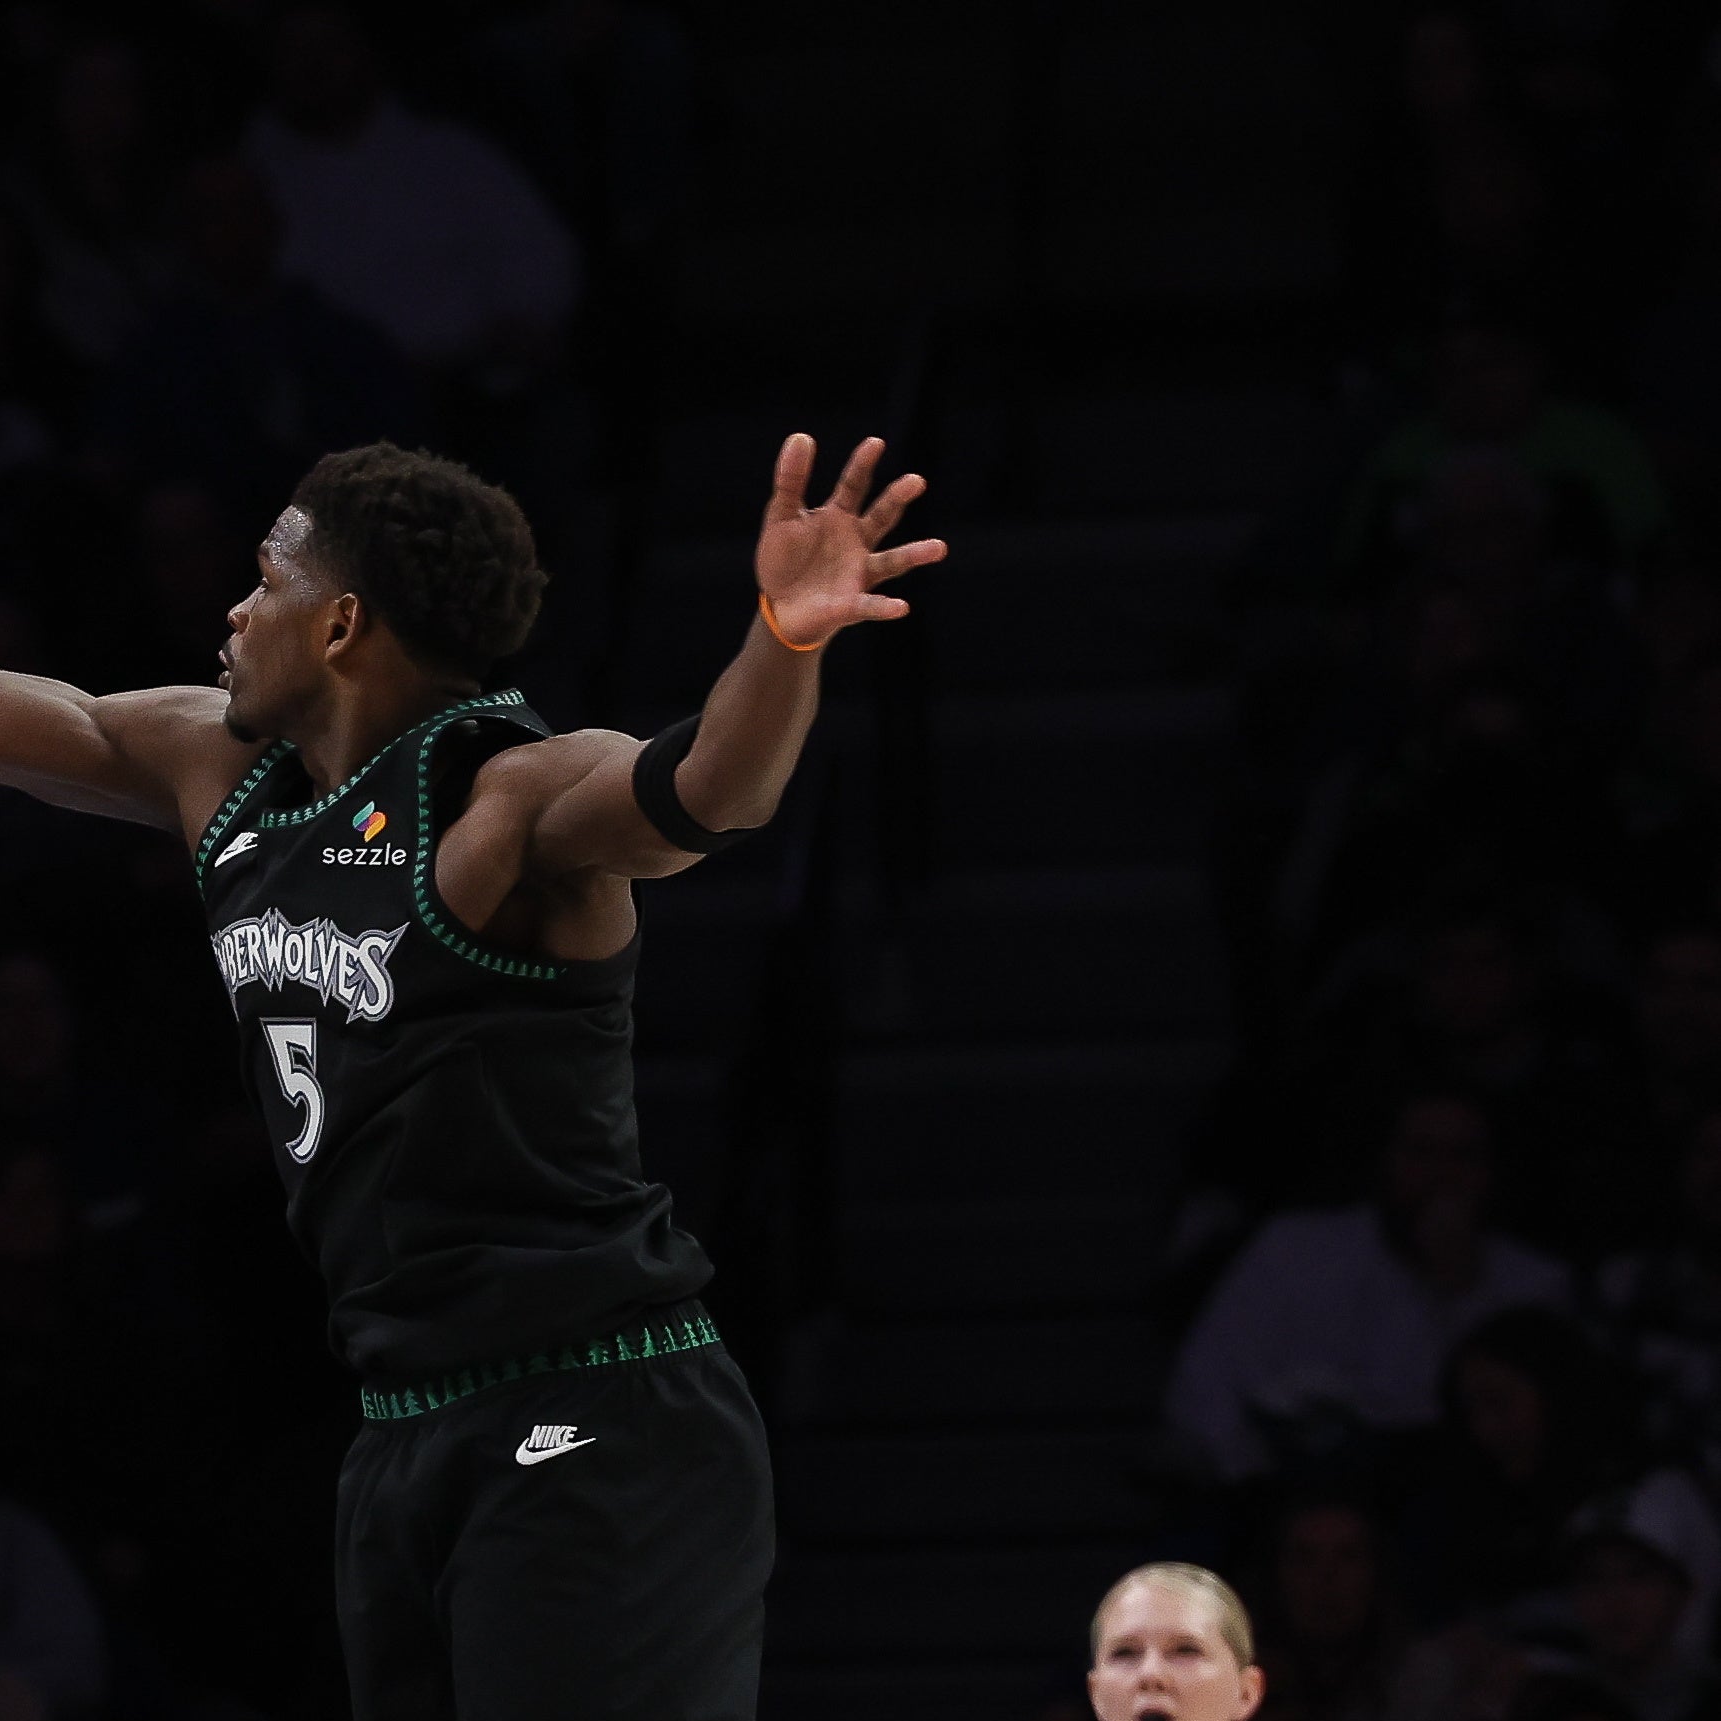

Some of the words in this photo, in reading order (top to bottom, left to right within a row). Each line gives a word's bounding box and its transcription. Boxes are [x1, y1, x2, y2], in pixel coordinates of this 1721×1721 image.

[321, 842, 408, 868] sezzle
[210, 907, 410, 1024] BERWOLVES
[259, 1016, 326, 1166] 5
[527, 1424, 579, 1449] NIKE
